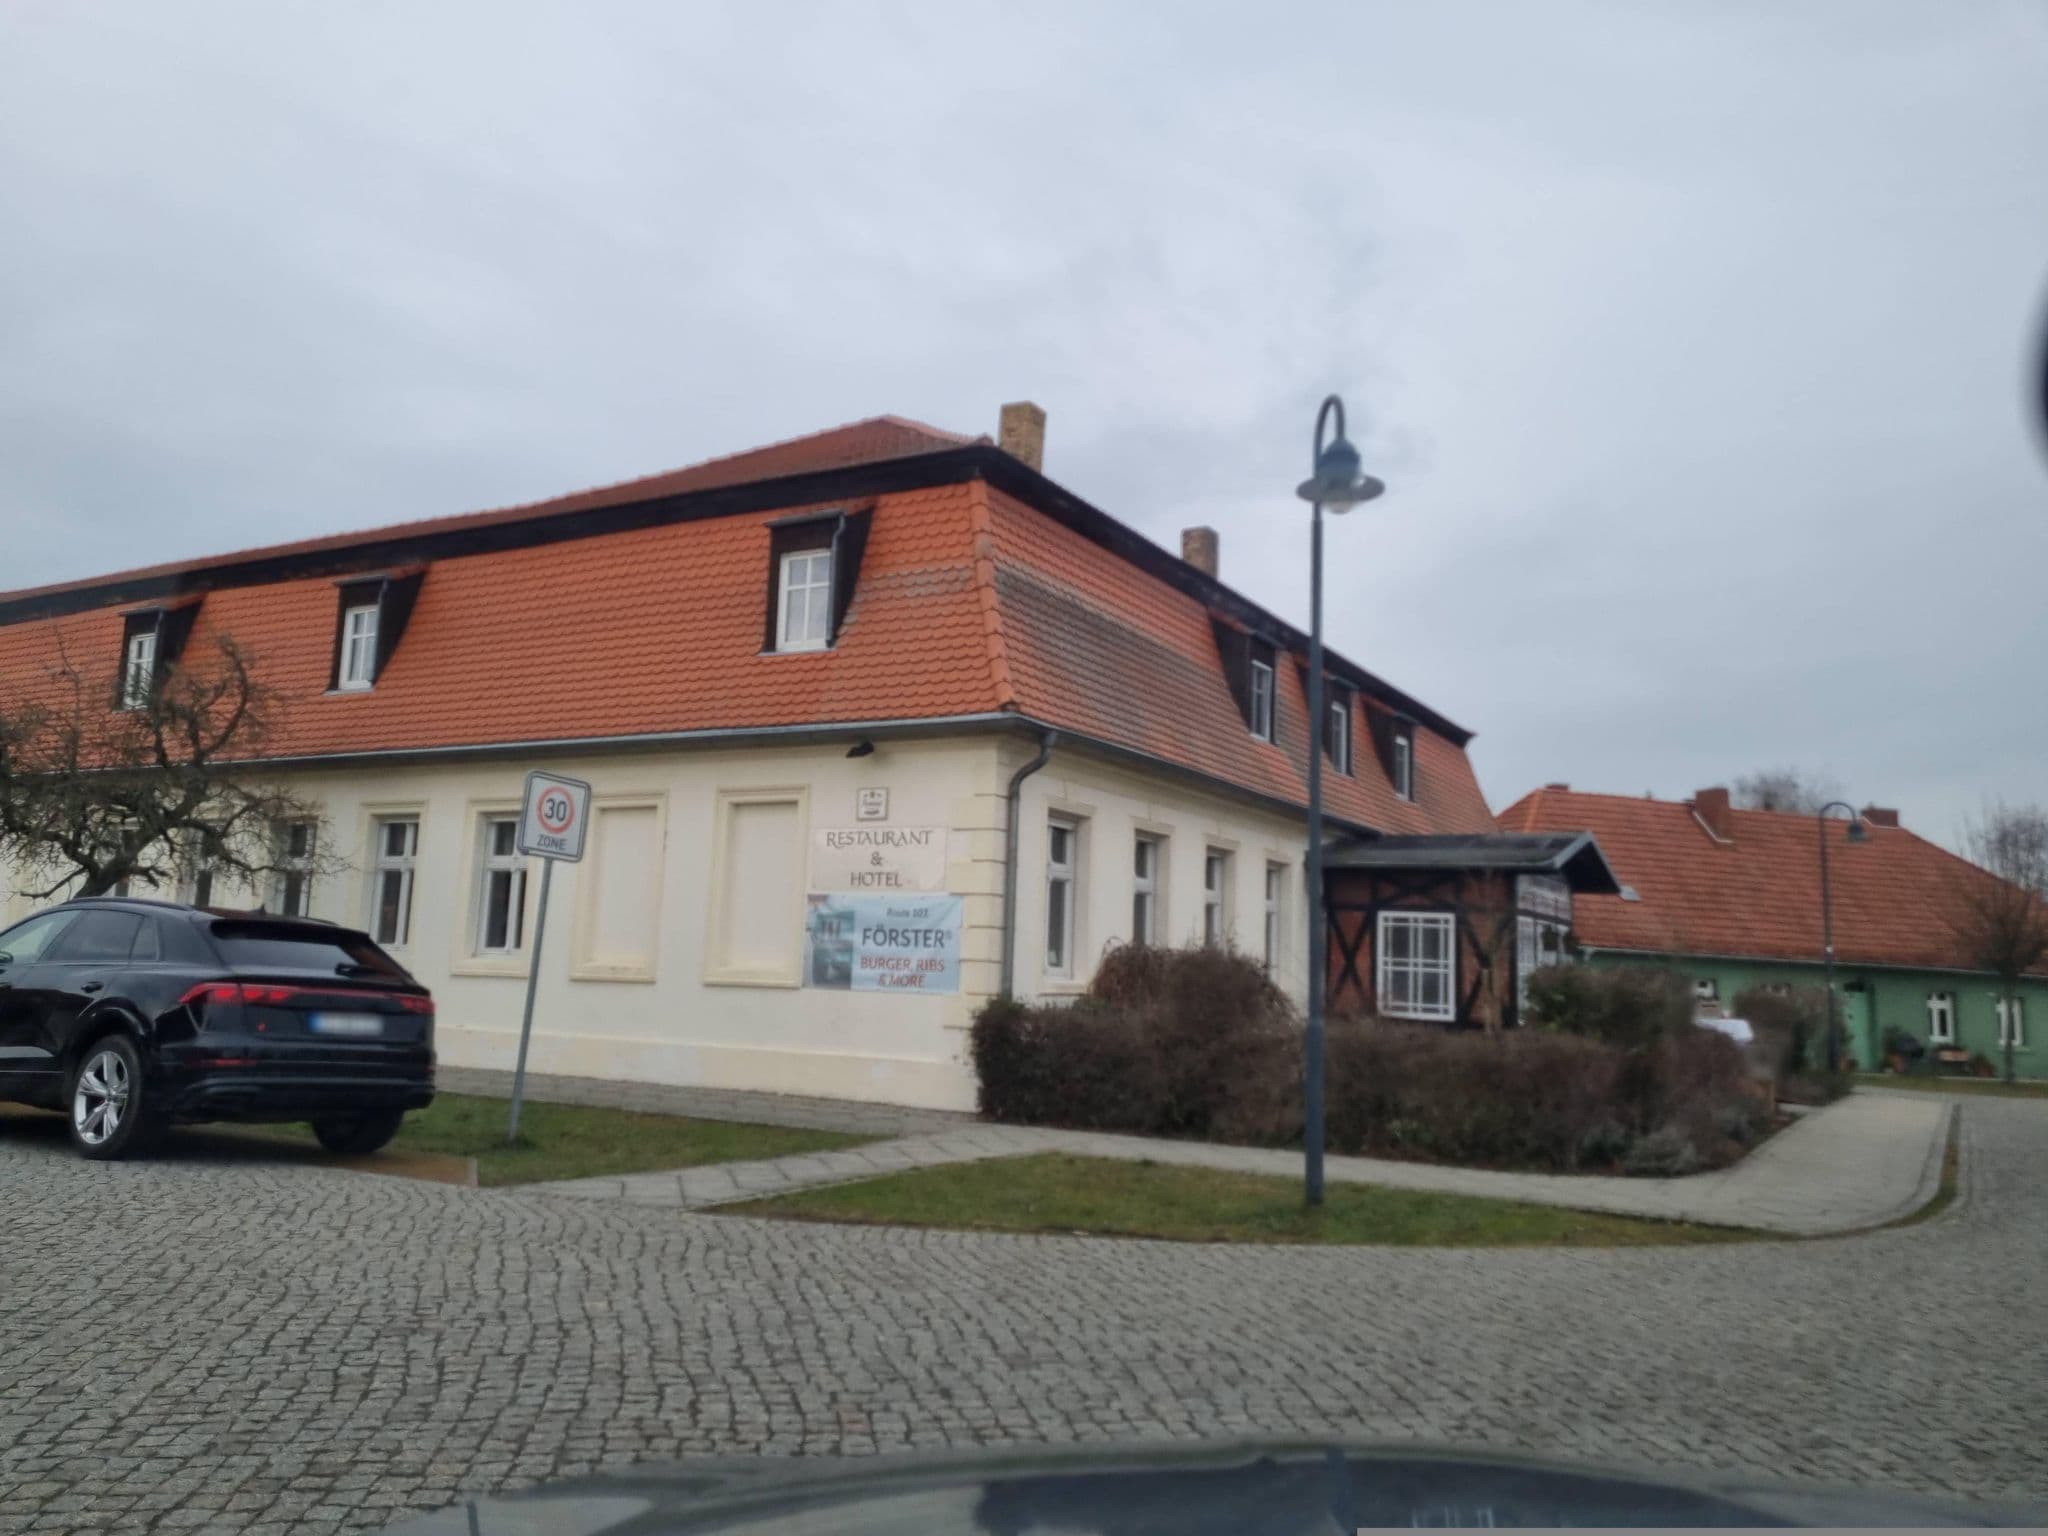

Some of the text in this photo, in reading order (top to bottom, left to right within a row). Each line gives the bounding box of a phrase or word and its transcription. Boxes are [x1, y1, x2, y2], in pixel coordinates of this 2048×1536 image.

[544, 798, 567, 822] 30
[537, 834, 567, 851] ZONE
[826, 830, 933, 848] RESTAURANT
[870, 851, 884, 866] &
[850, 872, 903, 887] HOTEL
[916, 958, 945, 973] RIBS
[889, 974, 926, 988] MORE
